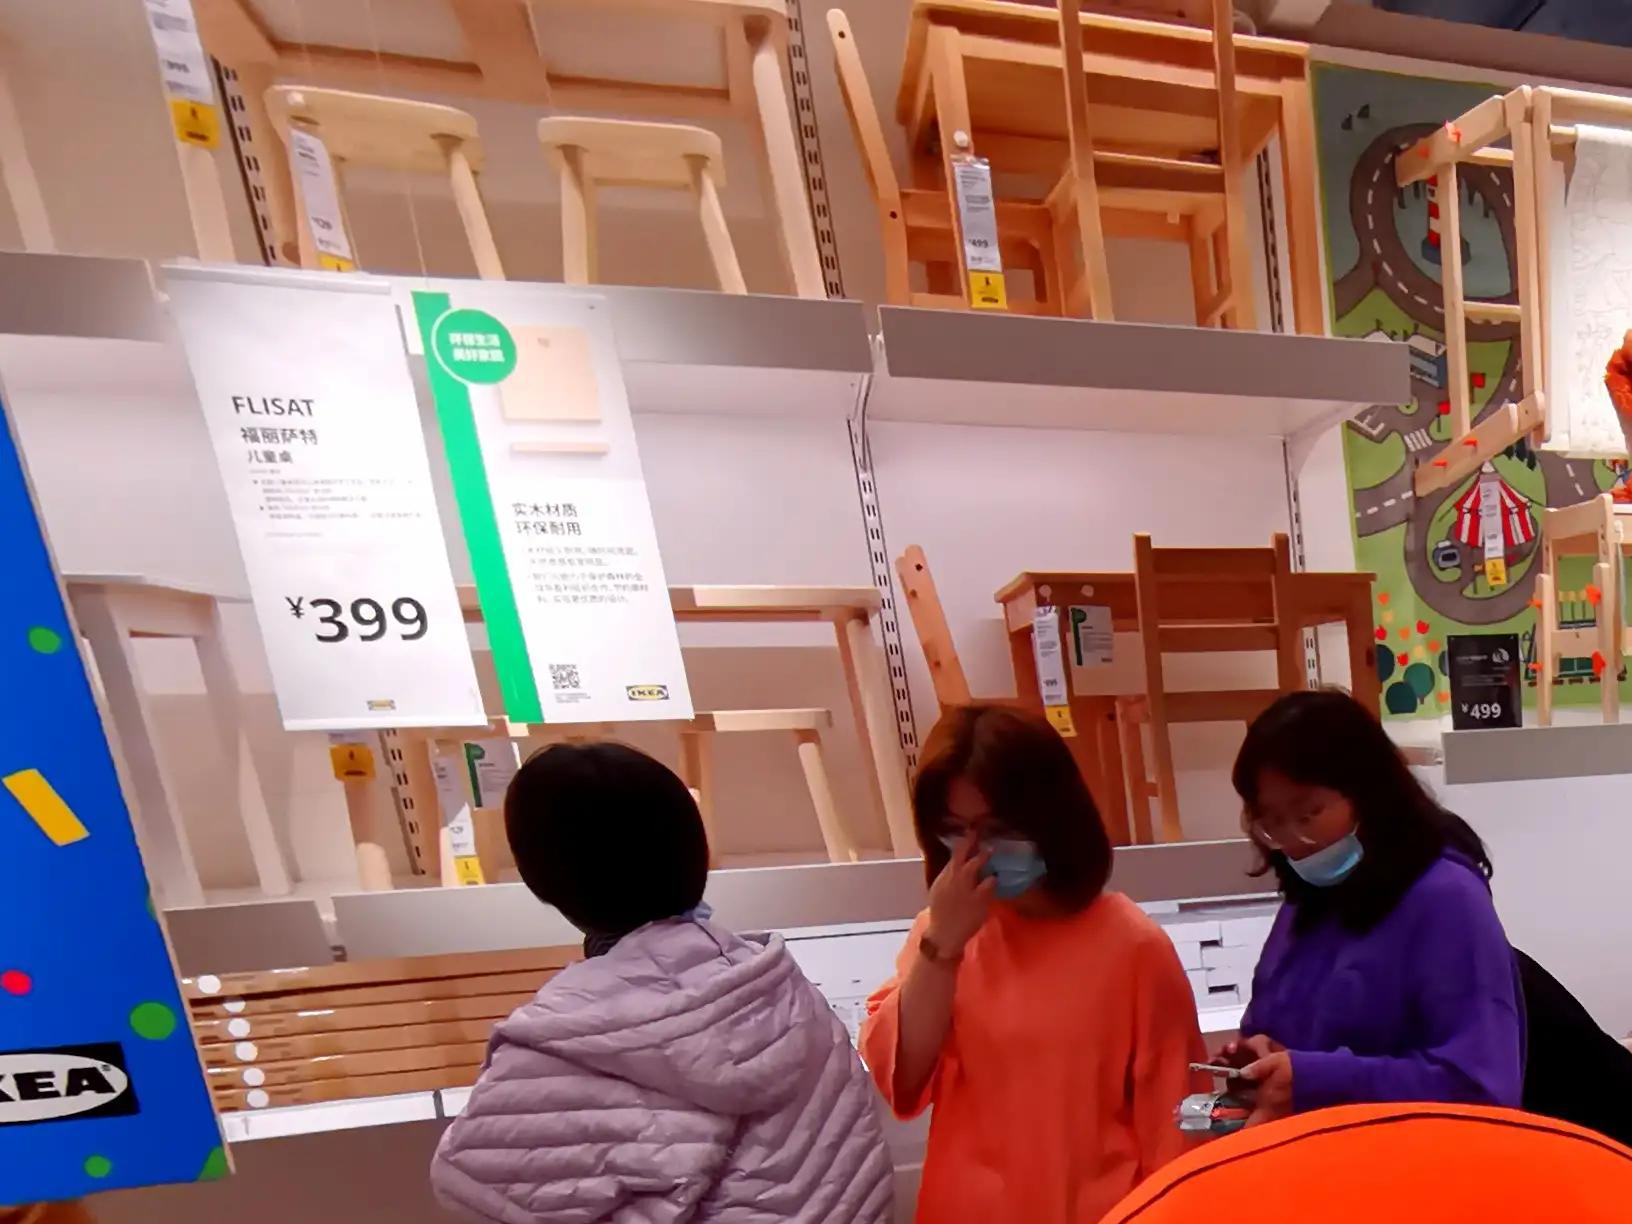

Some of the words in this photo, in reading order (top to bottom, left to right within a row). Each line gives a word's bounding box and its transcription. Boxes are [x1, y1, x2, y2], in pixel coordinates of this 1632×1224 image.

[231, 396, 315, 417] FLISAT
[240, 426, 319, 445] 福丽萨特
[248, 449, 293, 464] 儿童桌
[511, 502, 579, 518] 实木材质
[514, 519, 583, 536] 环保耐用
[284, 596, 429, 643] ¥399
[629, 687, 667, 699] IKEA
[1461, 702, 1502, 720] ¥499
[0, 1066, 117, 1102] EA
